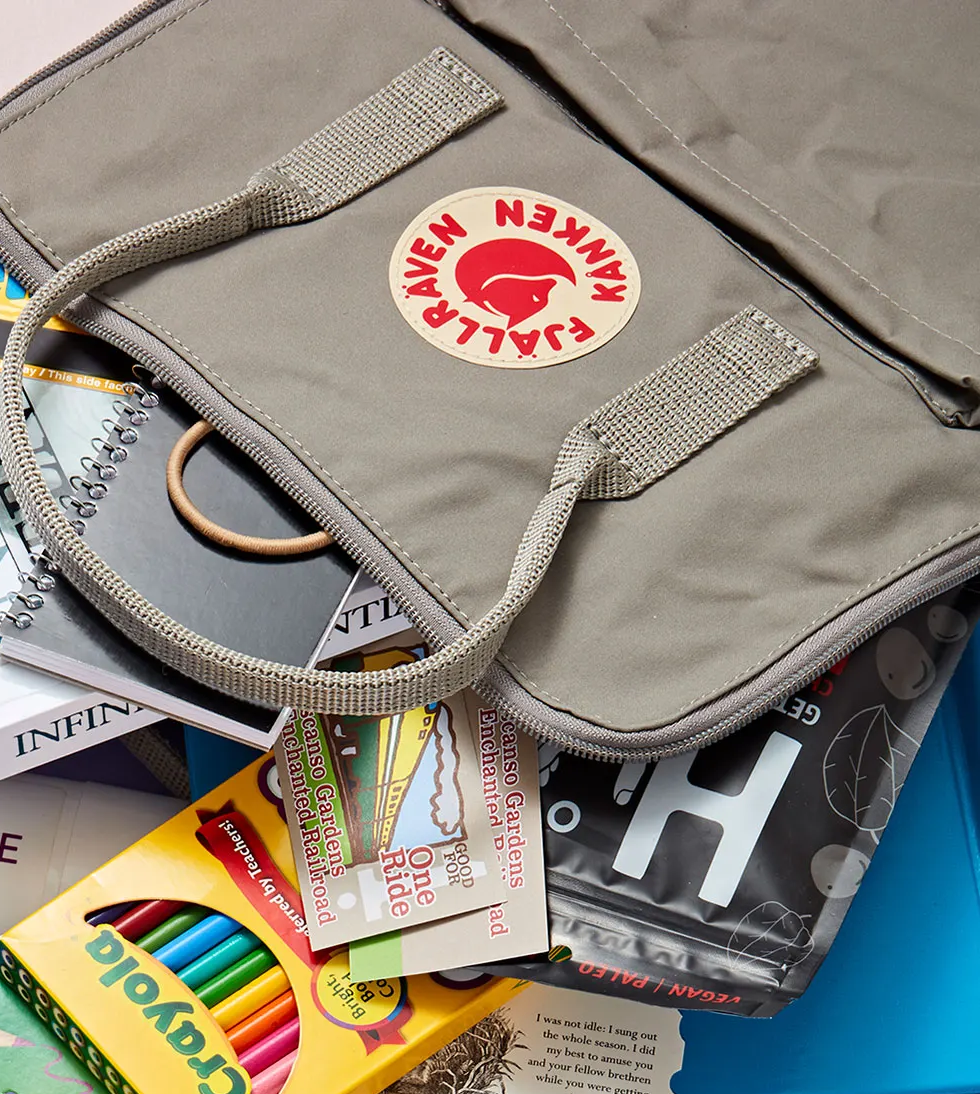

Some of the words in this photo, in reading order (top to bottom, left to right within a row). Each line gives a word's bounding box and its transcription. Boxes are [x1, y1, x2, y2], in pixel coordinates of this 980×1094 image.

[402, 213, 596, 359] FJÄLLRÄVEN
[48, 369, 73, 383] This
[76, 375, 101, 388] side
[13, 701, 144, 758] INFIN
[218, 818, 263, 882] Teachers!
[314, 783, 346, 878] Gardens
[504, 790, 527, 889] Gardens
[259, 876, 277, 896] by
[301, 824, 338, 928] Railroad
[379, 847, 411, 919] Ride
[408, 845, 436, 907] One
[443, 851, 461, 887] FOR
[455, 842, 475, 889] GOOD
[577, 960, 650, 989] PALEO
[669, 983, 742, 1004] VEGAN
[326, 973, 366, 1020] Bright,
[536, 1013, 541, 1022] I
[543, 1017, 562, 1026] was
[564, 1019, 581, 1029] not
[583, 1020, 606, 1033] idle:
[608, 1025, 613, 1034] I
[615, 1028, 638, 1041] sung
[640, 1032, 658, 1042] out
[542, 1029, 559, 1040] the
[561, 1032, 592, 1046] whole
[594, 1039, 630, 1052] season.
[632, 1043, 637, 1053] I
[639, 1044, 656, 1056] did
[527, 1058, 546, 1068] and
[548, 1062, 572, 1073] your
[574, 1063, 606, 1077] fellow
[608, 1068, 651, 1085] brethren
[546, 1046, 562, 1058] my
[564, 1047, 585, 1060] best
[587, 1051, 599, 1061] to
[600, 1055, 632, 1067] amuse
[634, 1062, 654, 1072] you
[535, 1073, 563, 1086] while
[564, 1079, 584, 1090] you
[587, 1083, 612, 1094] were
